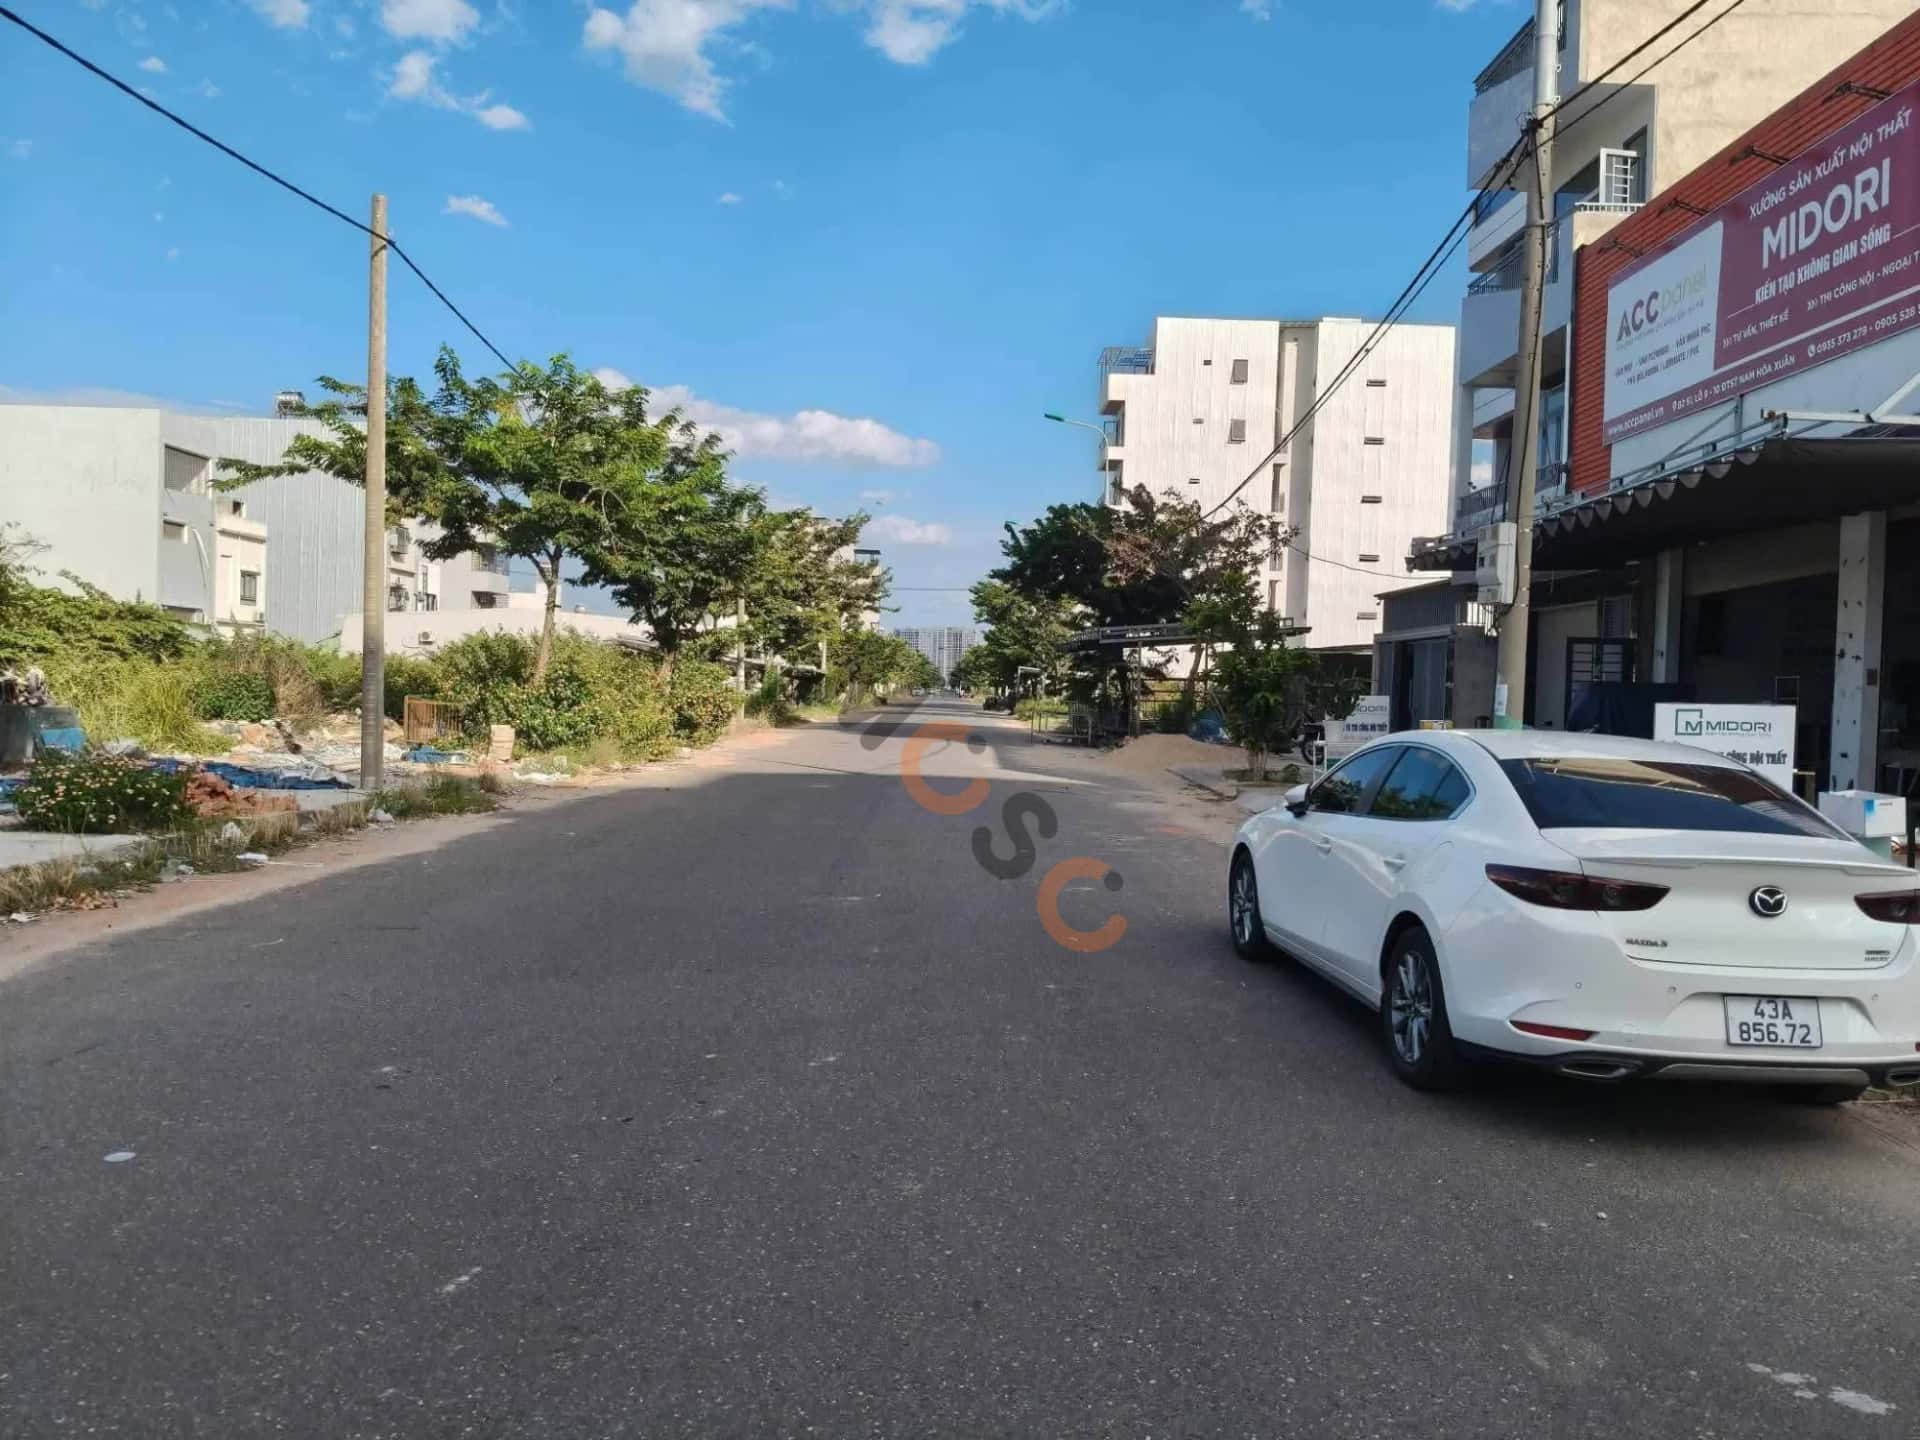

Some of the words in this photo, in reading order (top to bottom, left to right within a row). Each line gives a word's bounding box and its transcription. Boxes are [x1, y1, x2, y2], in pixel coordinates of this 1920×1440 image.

[1750, 187, 1787, 219] XƯỞNG
[1788, 170, 1812, 196] SẢN
[1815, 146, 1847, 181] XUẤT
[1850, 132, 1873, 160] NỘI
[1877, 106, 1913, 143] THẤT
[1762, 157, 1891, 270] MIDORI
[1755, 275, 1776, 305] KIẾN
[1777, 271, 1795, 296] TẠO
[1797, 253, 1830, 285] KHÔNG
[1832, 240, 1857, 268] GIAN
[1860, 223, 1891, 254] SỐNG
[1834, 279, 1857, 299] CÔNG
[1859, 269, 1875, 289] NỘI
[1882, 254, 1912, 278] NGOẠI
[1706, 720, 1772, 733] MIDORI
[1754, 1000, 1793, 1021] 43A
[1738, 1023, 1813, 1045] 856.72
